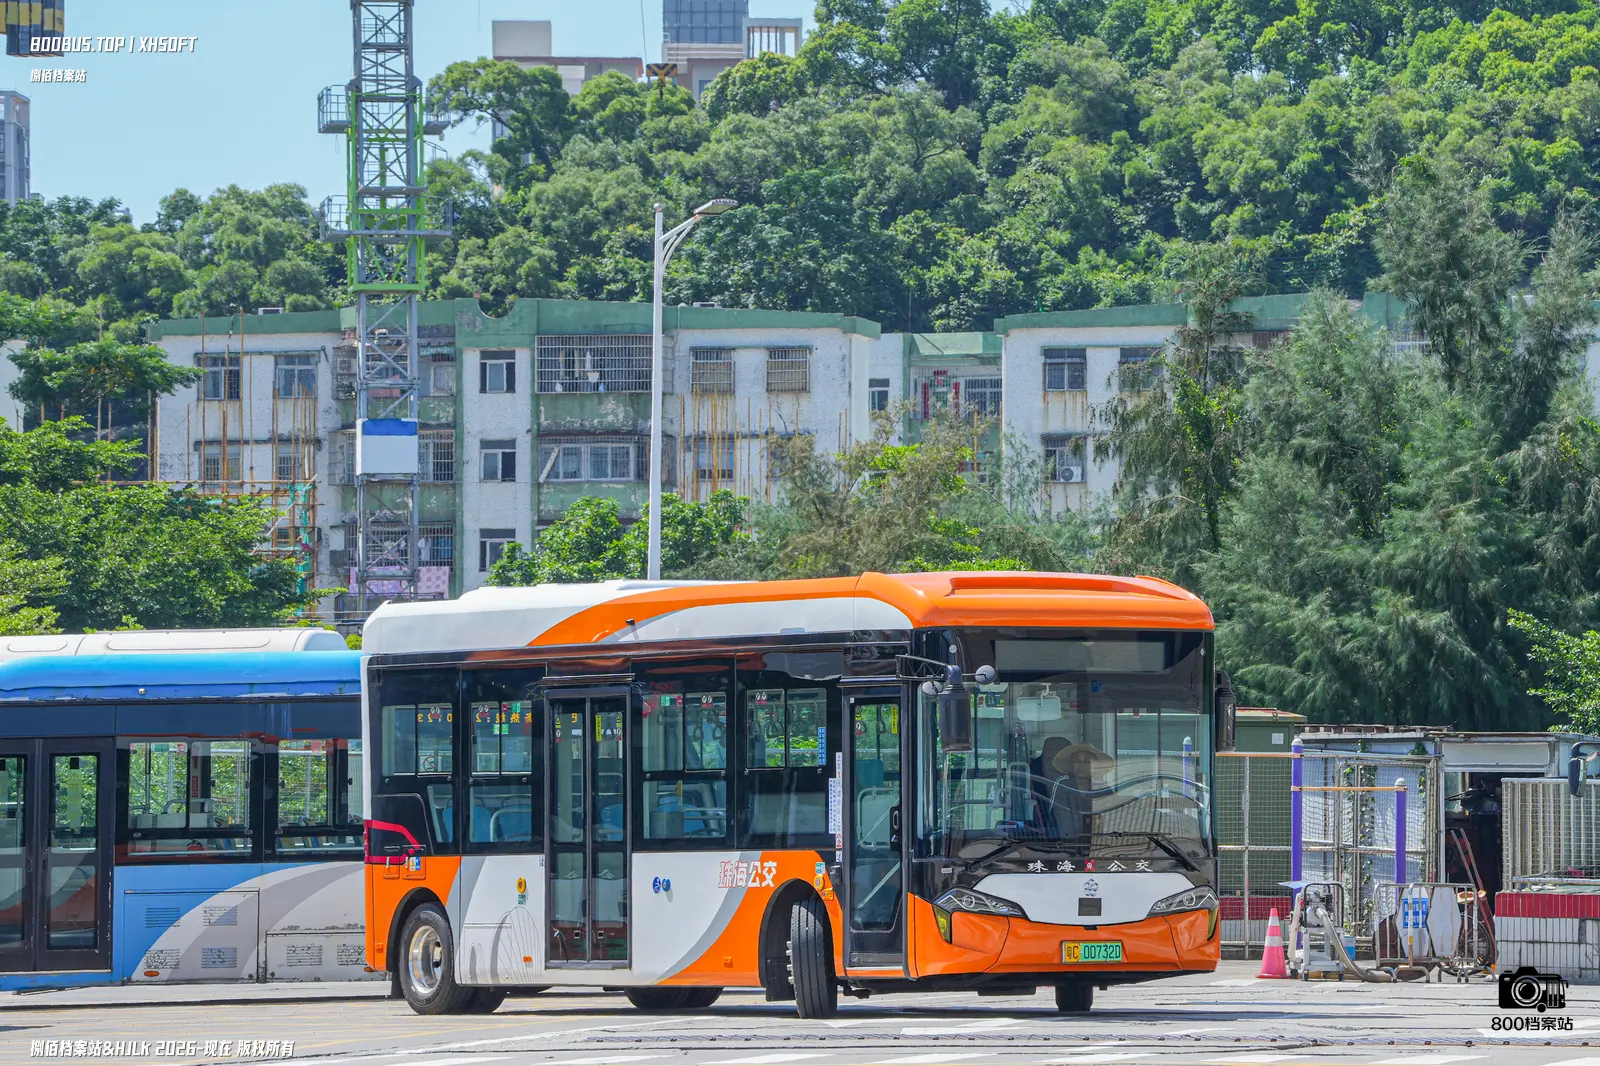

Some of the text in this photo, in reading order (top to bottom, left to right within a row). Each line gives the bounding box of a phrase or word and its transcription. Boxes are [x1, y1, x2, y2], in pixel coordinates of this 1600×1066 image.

[718, 860, 777, 888] 珠海公交
[1027, 859, 1153, 873] 珠海 公交
